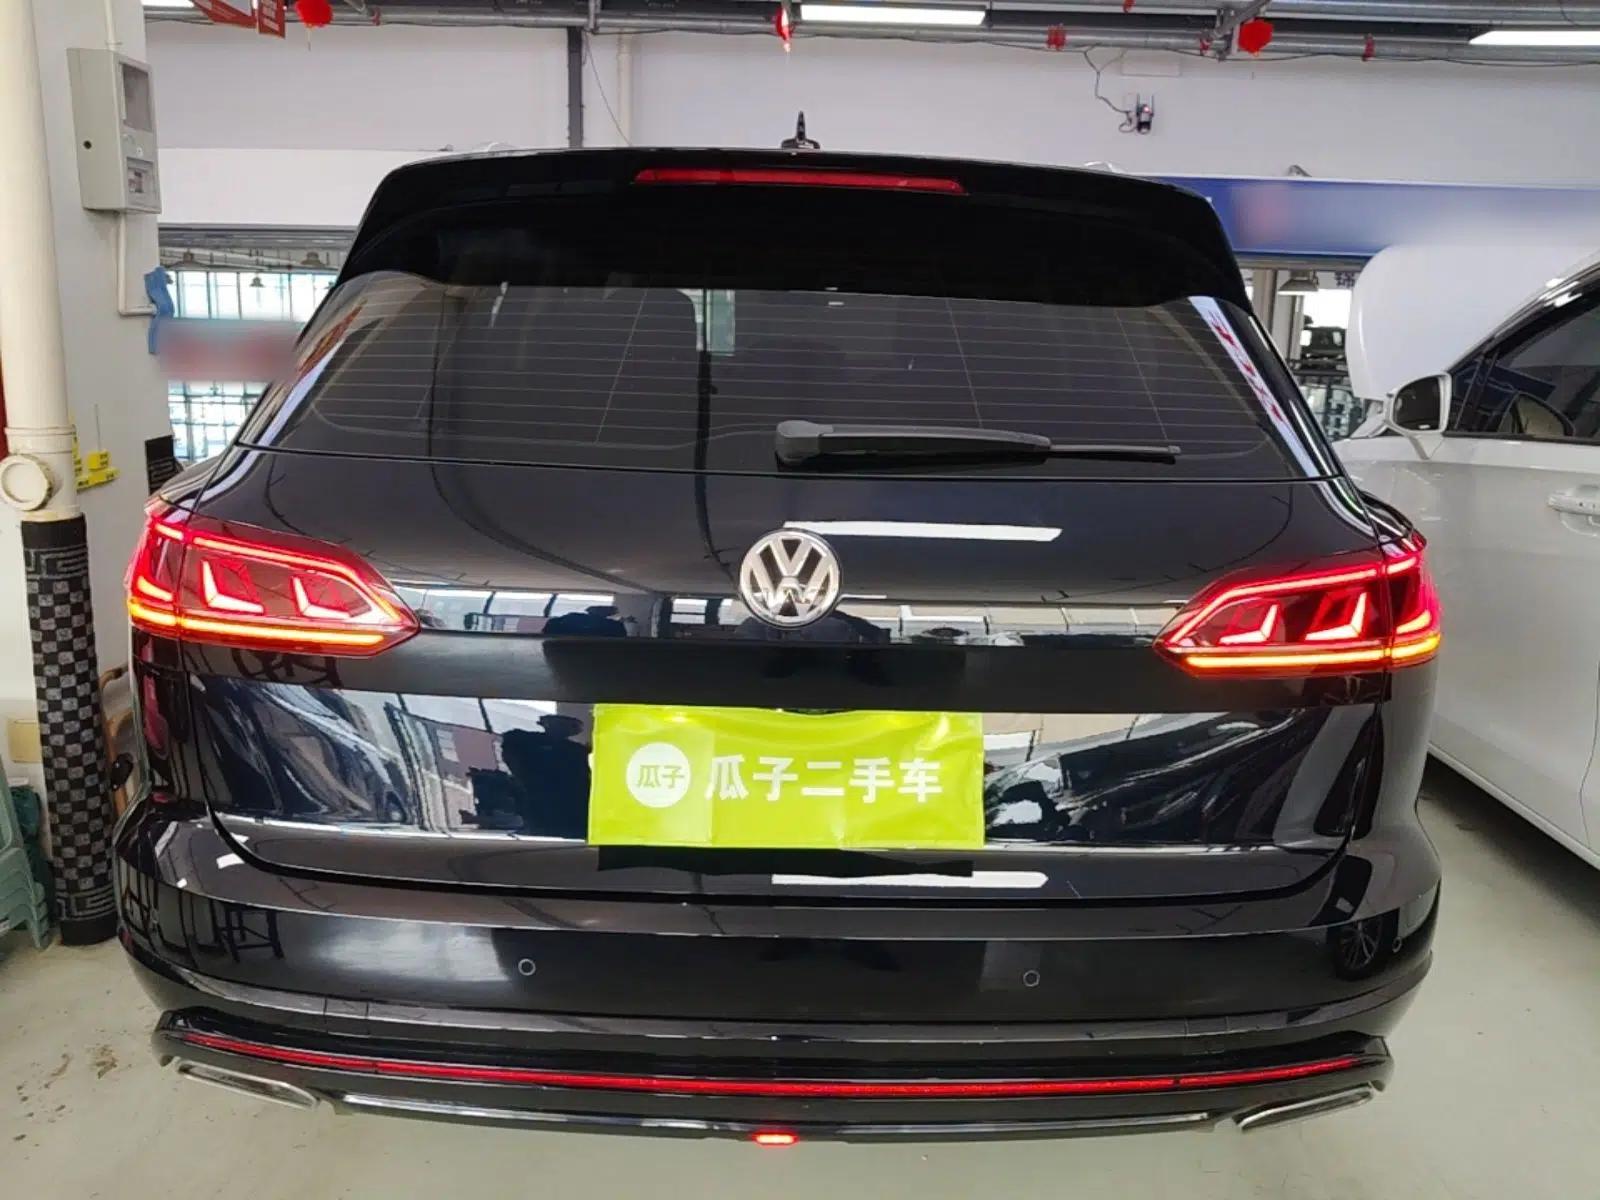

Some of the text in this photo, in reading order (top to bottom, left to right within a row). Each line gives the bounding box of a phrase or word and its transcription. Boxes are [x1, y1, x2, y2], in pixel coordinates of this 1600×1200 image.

[637, 764, 685, 789] 瓜子
[704, 754, 943, 803] 瓜子二手车
